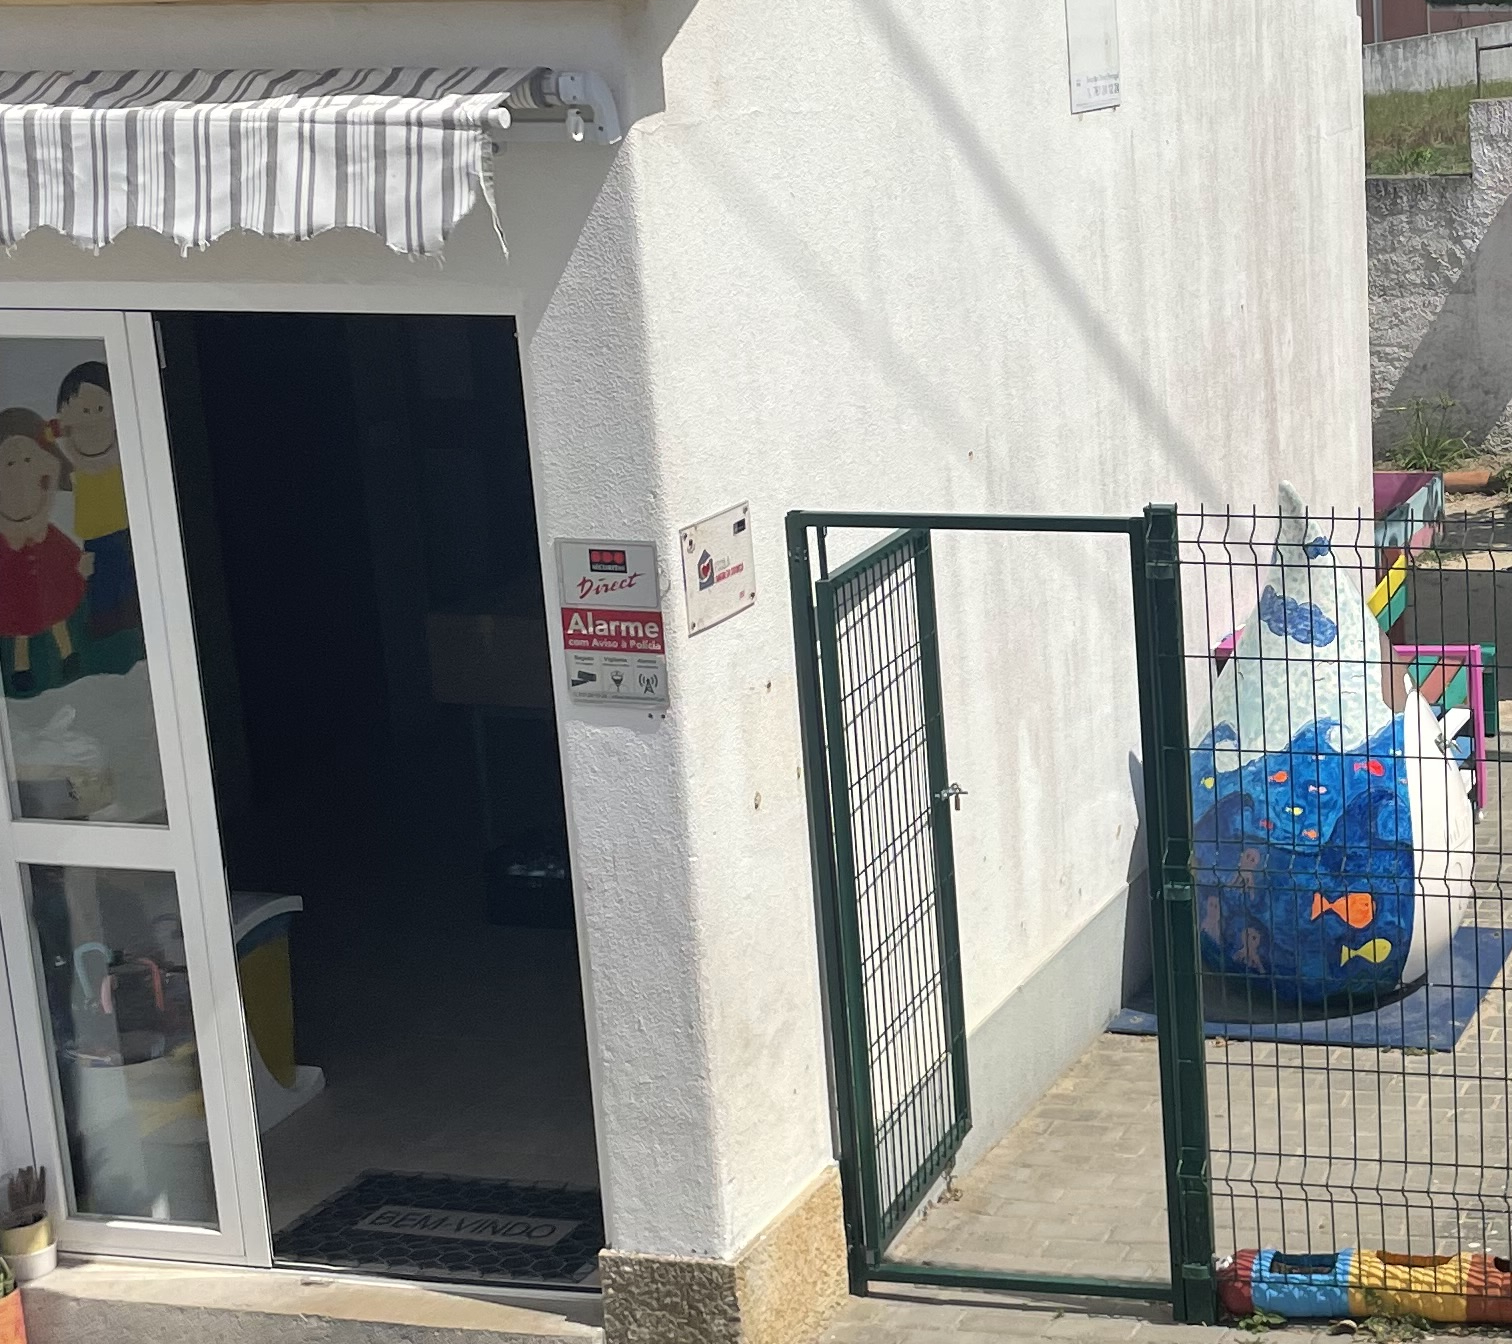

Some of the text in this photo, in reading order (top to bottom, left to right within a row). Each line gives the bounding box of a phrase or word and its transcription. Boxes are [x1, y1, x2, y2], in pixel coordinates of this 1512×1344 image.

[576, 571, 645, 599] Direct
[567, 612, 660, 639] Alarme
[568, 638, 589, 647] com
[592, 637, 619, 648] Aviso
[630, 639, 661, 650] Polícia
[368, 1209, 557, 1239] BEM-VINDO
